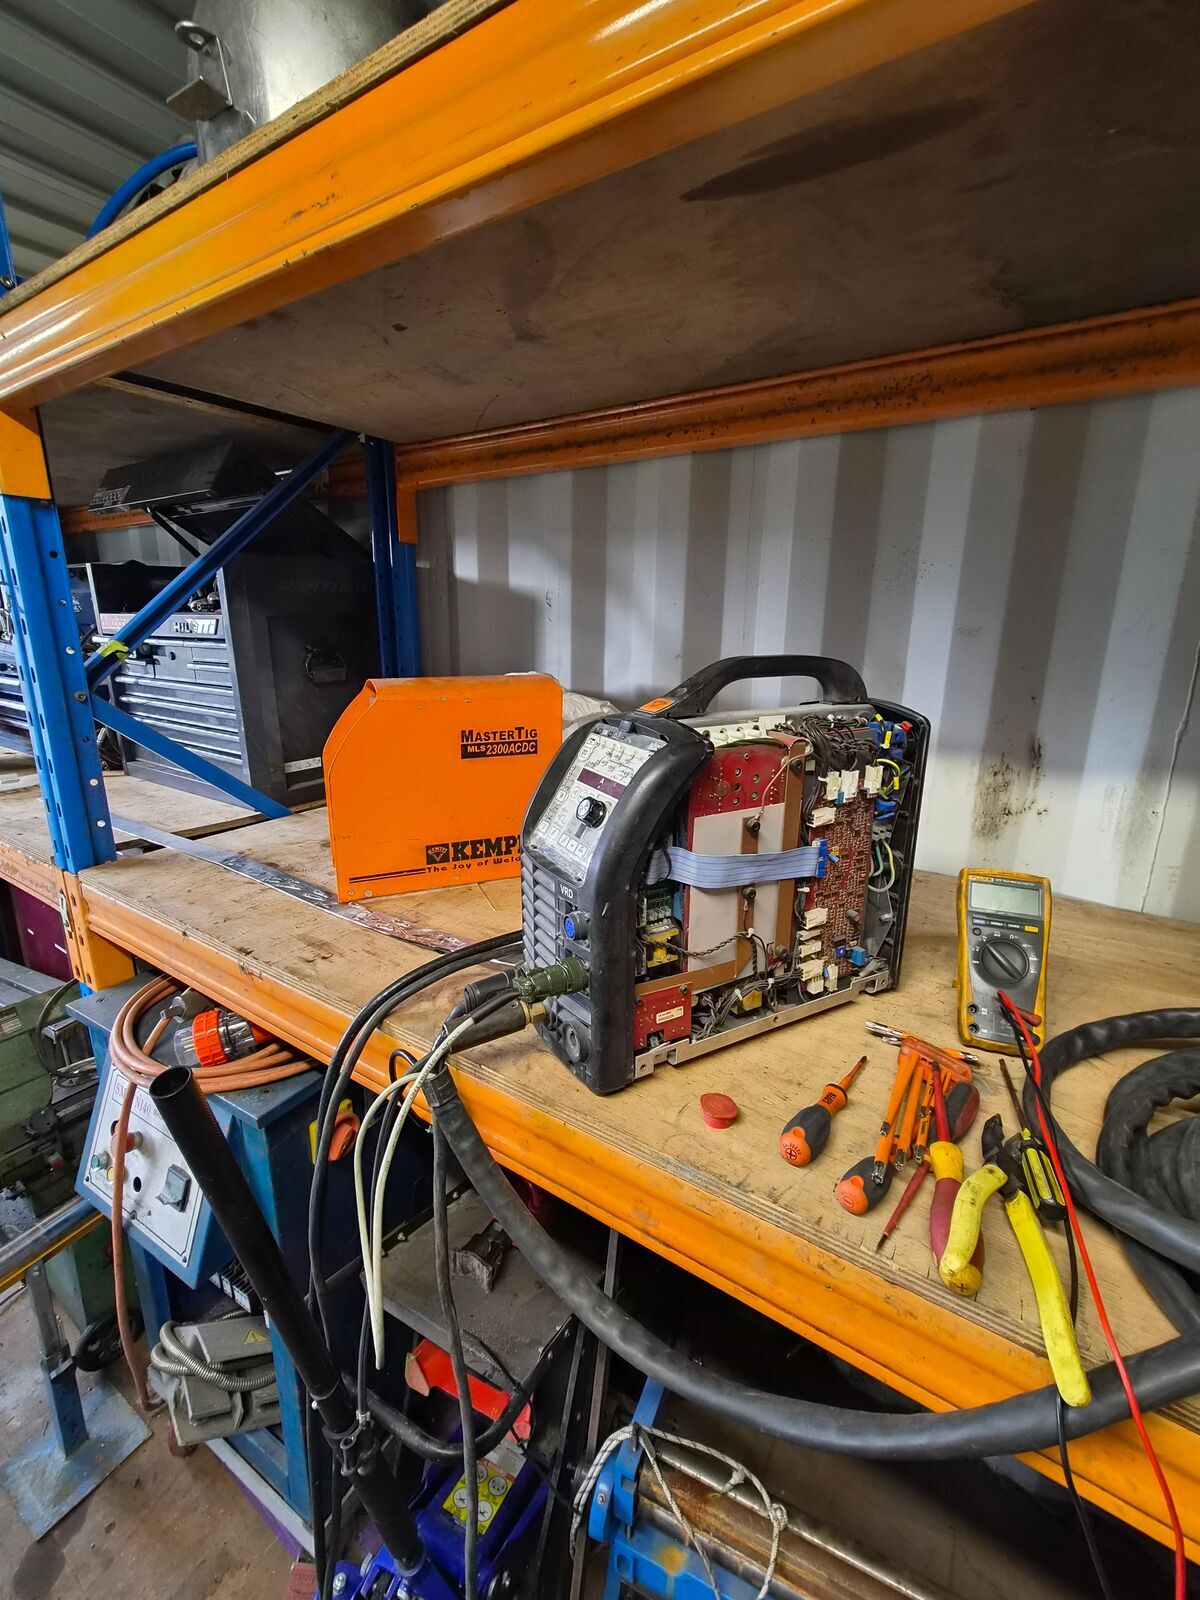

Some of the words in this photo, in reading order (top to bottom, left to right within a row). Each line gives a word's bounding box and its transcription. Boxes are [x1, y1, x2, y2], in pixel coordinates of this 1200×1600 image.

[467, 745, 486, 753] MLS
[486, 741, 536, 755] 2300ACDC
[477, 859, 489, 867] of
[560, 884, 574, 899] VRD
